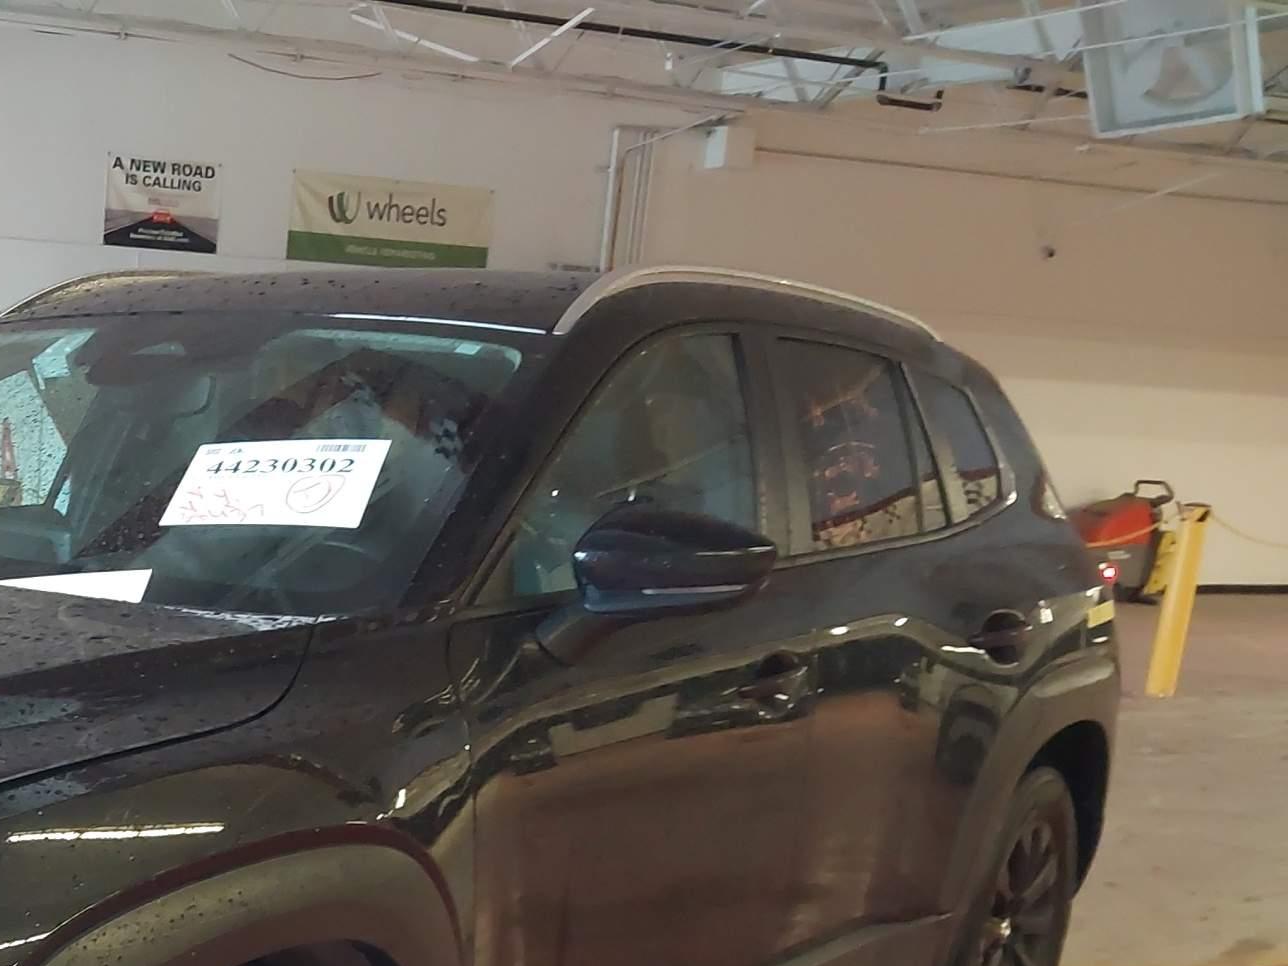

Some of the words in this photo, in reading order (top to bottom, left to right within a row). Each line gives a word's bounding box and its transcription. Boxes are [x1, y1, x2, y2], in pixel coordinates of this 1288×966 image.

[112, 156, 124, 170] A
[129, 158, 167, 174] NEW
[171, 162, 216, 179] ROAD
[125, 173, 138, 186] IS
[142, 175, 202, 192] CALLING
[366, 193, 448, 227] wheels
[206, 457, 356, 475] 44230302
